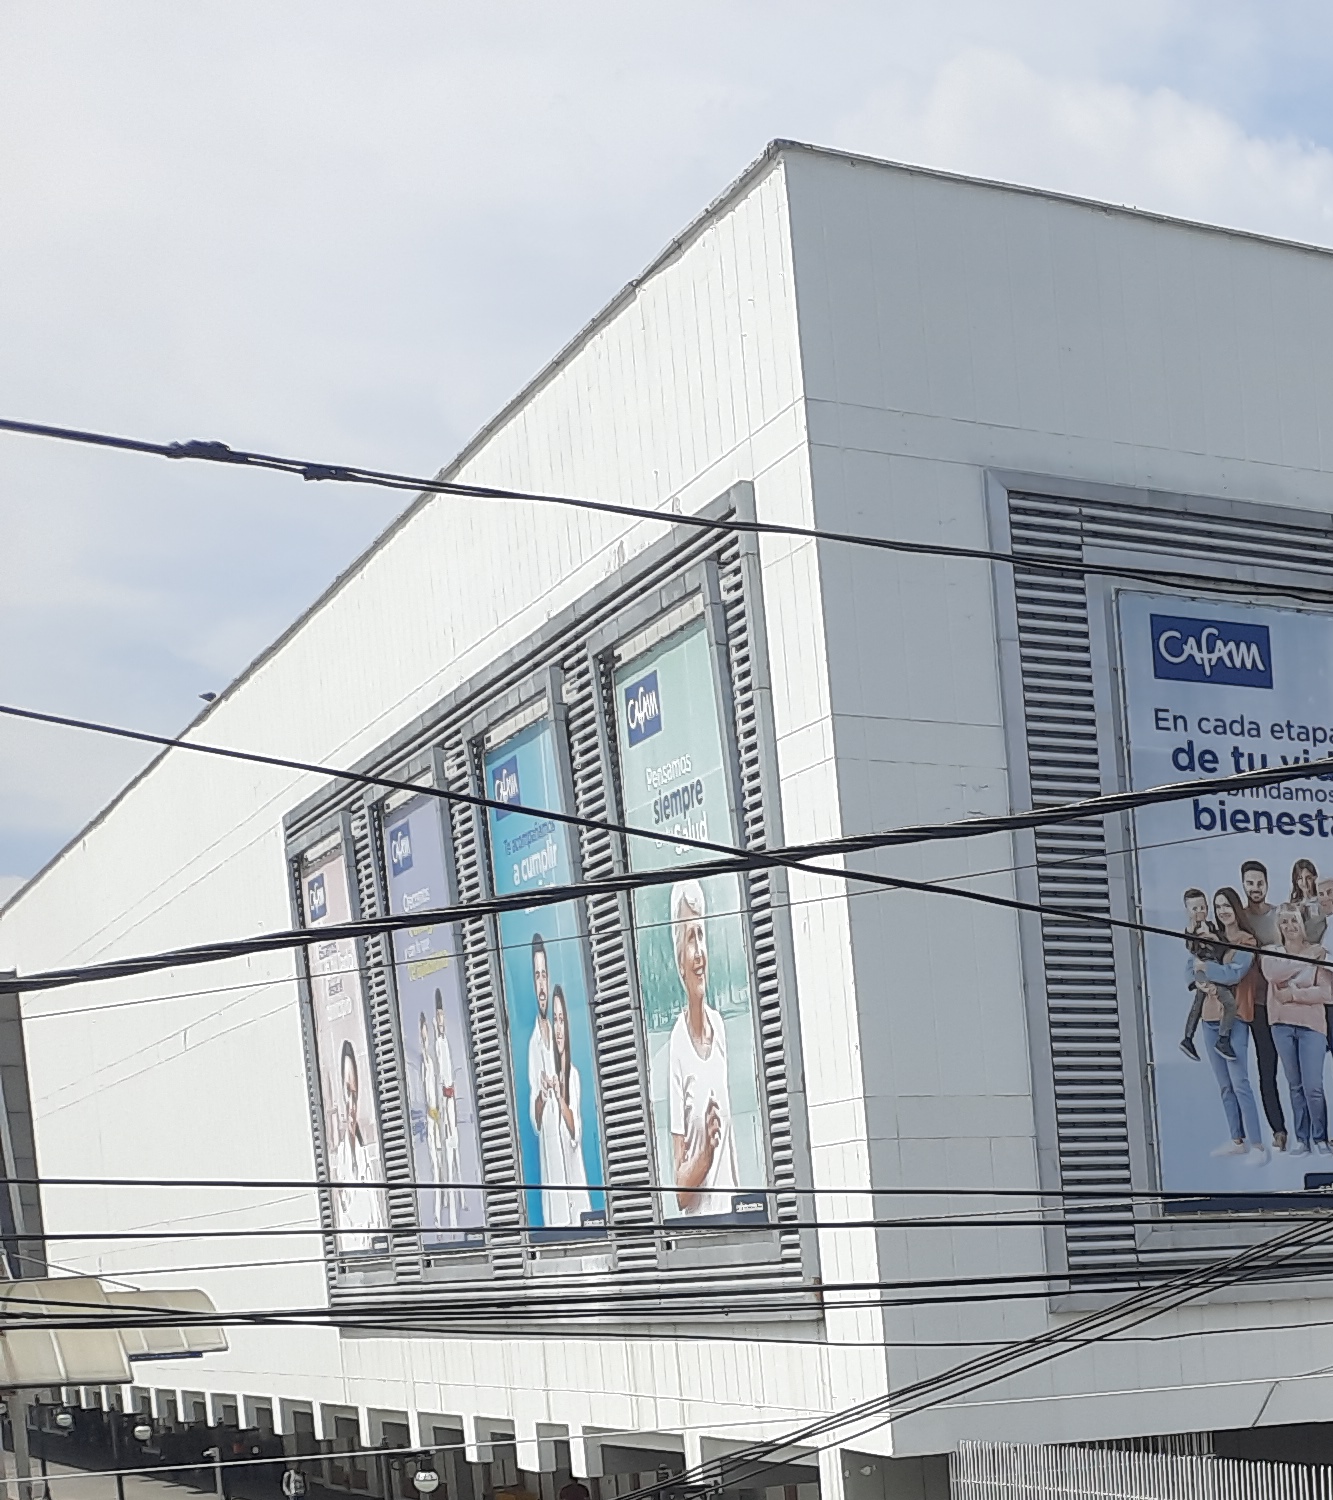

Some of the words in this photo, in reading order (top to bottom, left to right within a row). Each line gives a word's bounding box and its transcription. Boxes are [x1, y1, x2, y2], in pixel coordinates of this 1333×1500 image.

[1154, 707, 1188, 733] En
[1197, 714, 1262, 738] cada
[1172, 739, 1219, 773] de
[1231, 746, 1268, 775] tu
[653, 778, 704, 825] siempre
[513, 863, 521, 887] a
